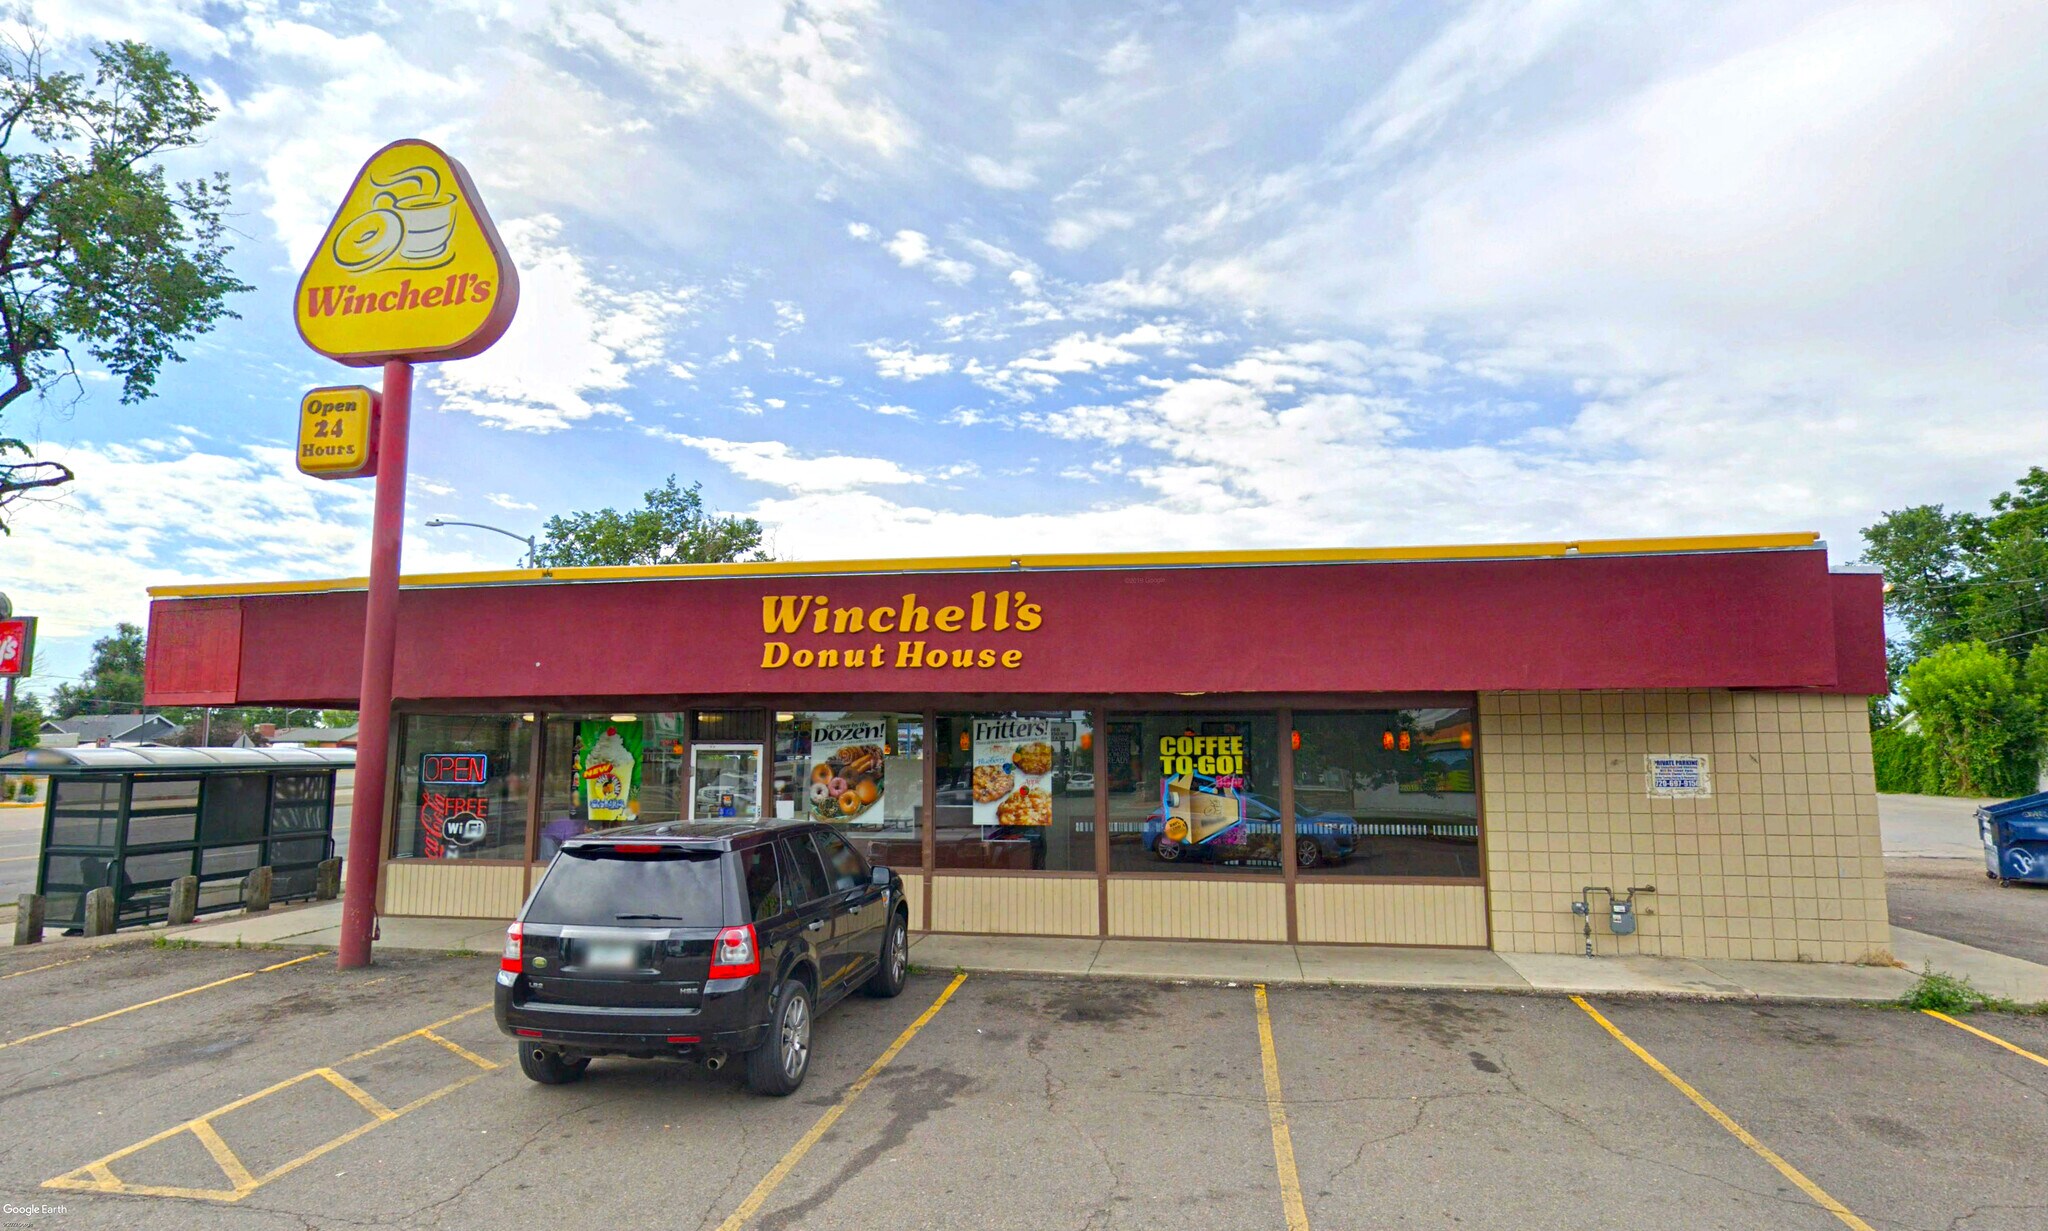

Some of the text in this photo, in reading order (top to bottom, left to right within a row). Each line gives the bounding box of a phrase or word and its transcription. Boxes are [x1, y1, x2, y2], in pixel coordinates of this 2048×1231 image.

[307, 273, 491, 317] Winchell's
[307, 400, 357, 416] Open
[314, 418, 343, 438] 24
[302, 443, 355, 457] Hours
[762, 591, 1042, 633] Winchell's
[760, 641, 1023, 668] Donut House
[814, 723, 885, 743] Dozen!
[976, 720, 1049, 741] Fritters!
[1160, 736, 1243, 756] COFFEE
[425, 757, 485, 781] OPEN
[584, 764, 611, 778] NEW
[444, 797, 488, 817] FREE
[679, 987, 700, 995] HSE
